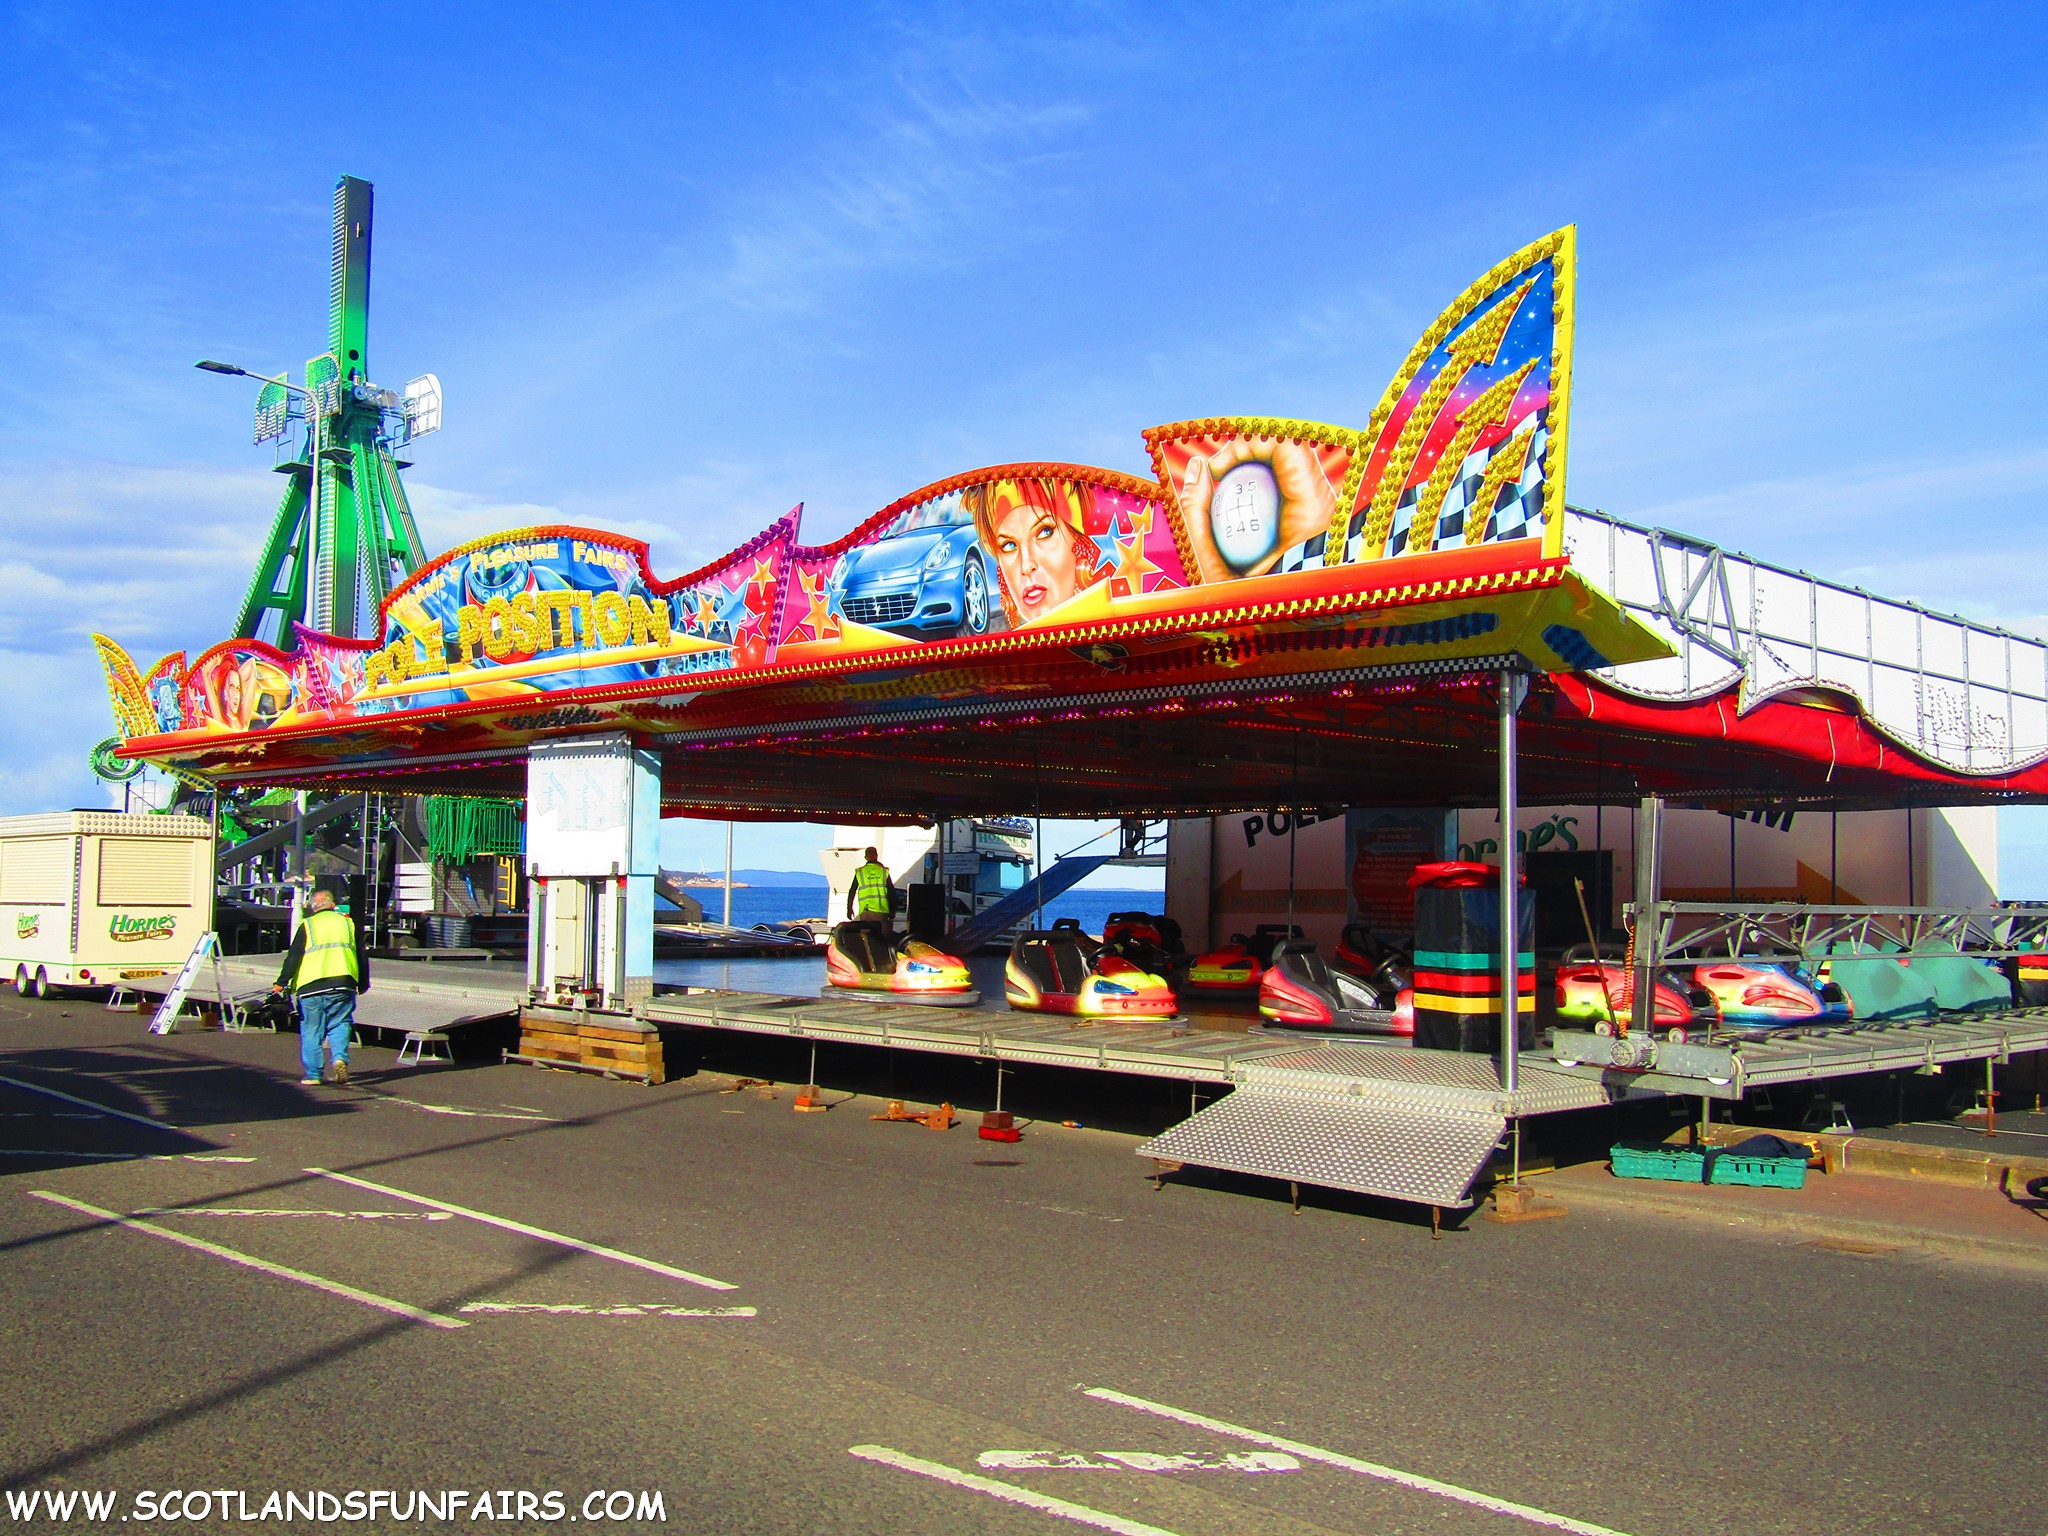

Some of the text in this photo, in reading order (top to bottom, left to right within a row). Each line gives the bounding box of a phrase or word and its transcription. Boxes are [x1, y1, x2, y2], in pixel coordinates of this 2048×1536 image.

[1235, 481, 1257, 494] 3 5
[1225, 525, 1233, 538] 2
[1236, 519, 1246, 533] 4
[391, 541, 628, 620] HORNE'S PLEASURE FAIRS
[365, 590, 671, 693] POLE POSITION
[116, 930, 163, 941] Pleasure Fairs
